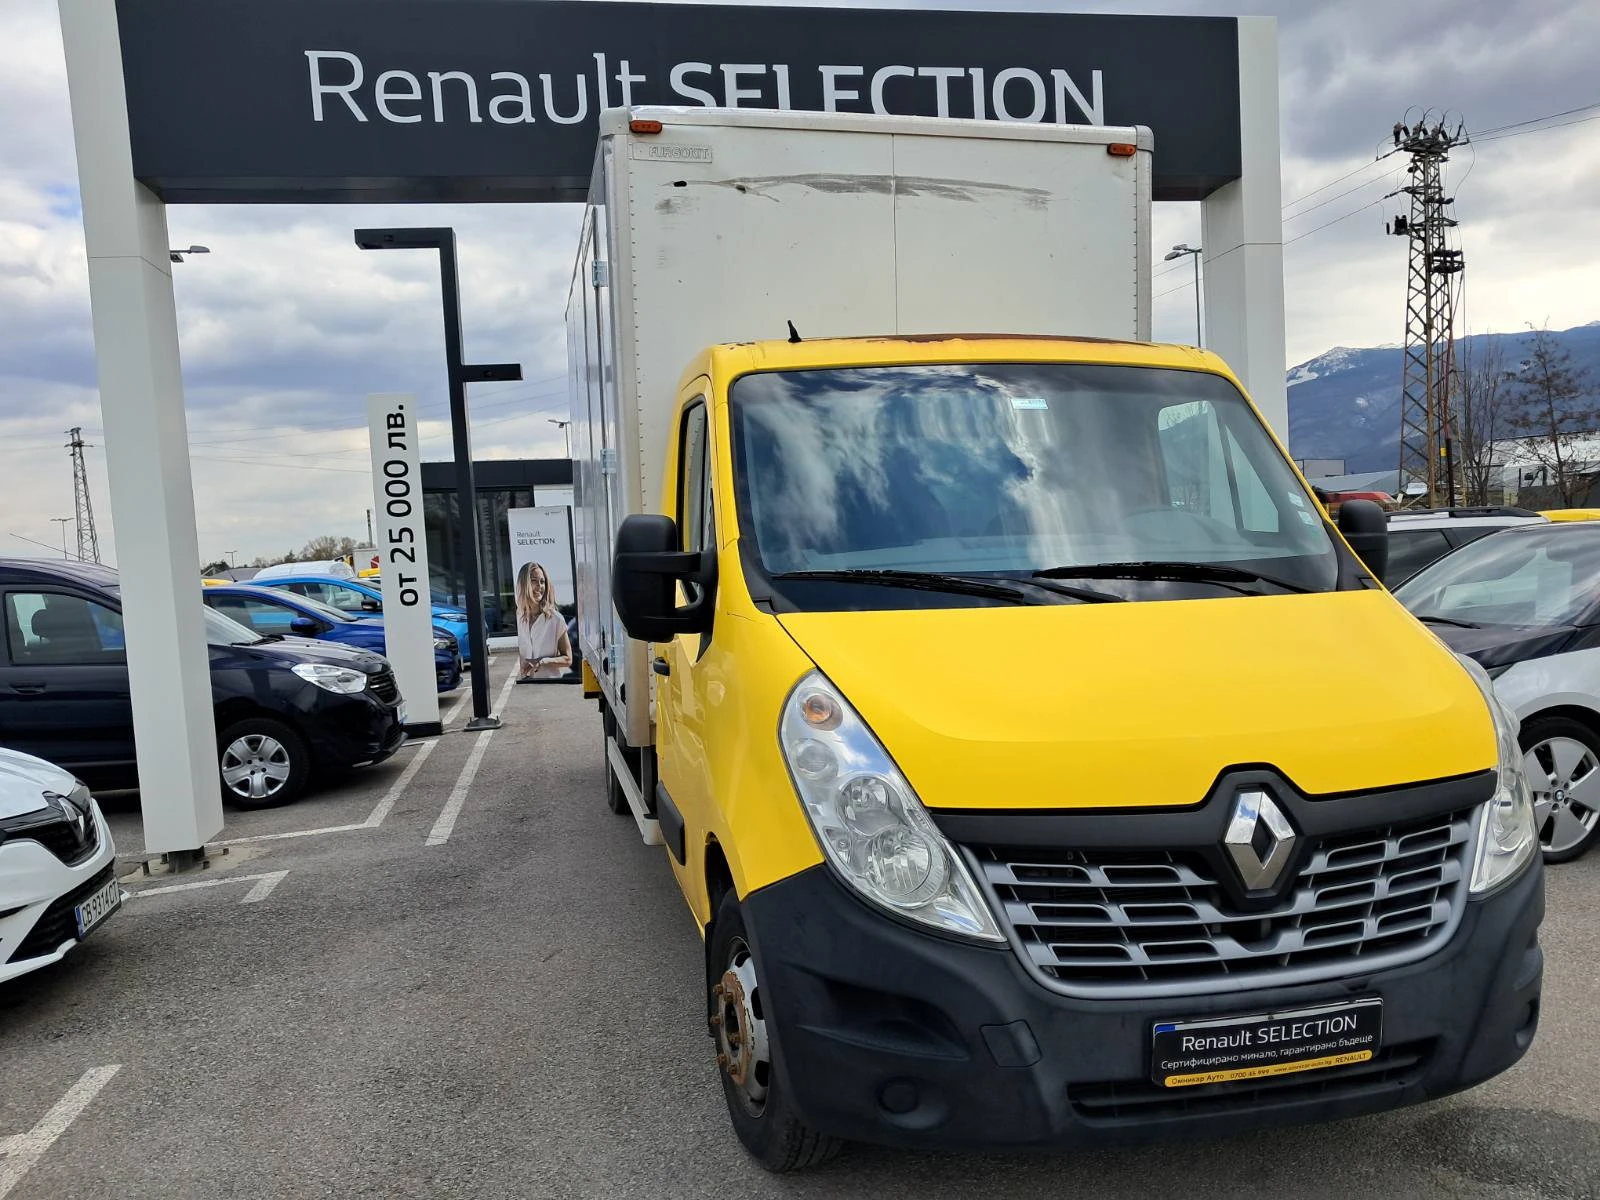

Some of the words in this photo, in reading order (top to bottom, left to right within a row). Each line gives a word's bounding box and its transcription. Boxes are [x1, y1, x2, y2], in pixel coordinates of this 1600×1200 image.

[304, 50, 647, 124] Renault
[386, 404, 408, 451] лв.
[383, 459, 413, 518] 000
[388, 527, 416, 563] 25
[516, 530, 542, 538] Renault
[516, 538, 556, 546] SELECTION
[398, 573, 419, 607] от
[1182, 1029, 1252, 1052] Renault
[1256, 1014, 1358, 1044] SELECTION
[1161, 1054, 1239, 1070] Сертифицирано
[1240, 1050, 1279, 1060] минало,
[1280, 1041, 1337, 1057] гарантирано
[1338, 1034, 1373, 1047] бъдеще
[1207, 1074, 1225, 1082] Ауто
[1230, 1071, 1247, 1079] 0700
[1335, 1052, 1367, 1064] RENAULT
